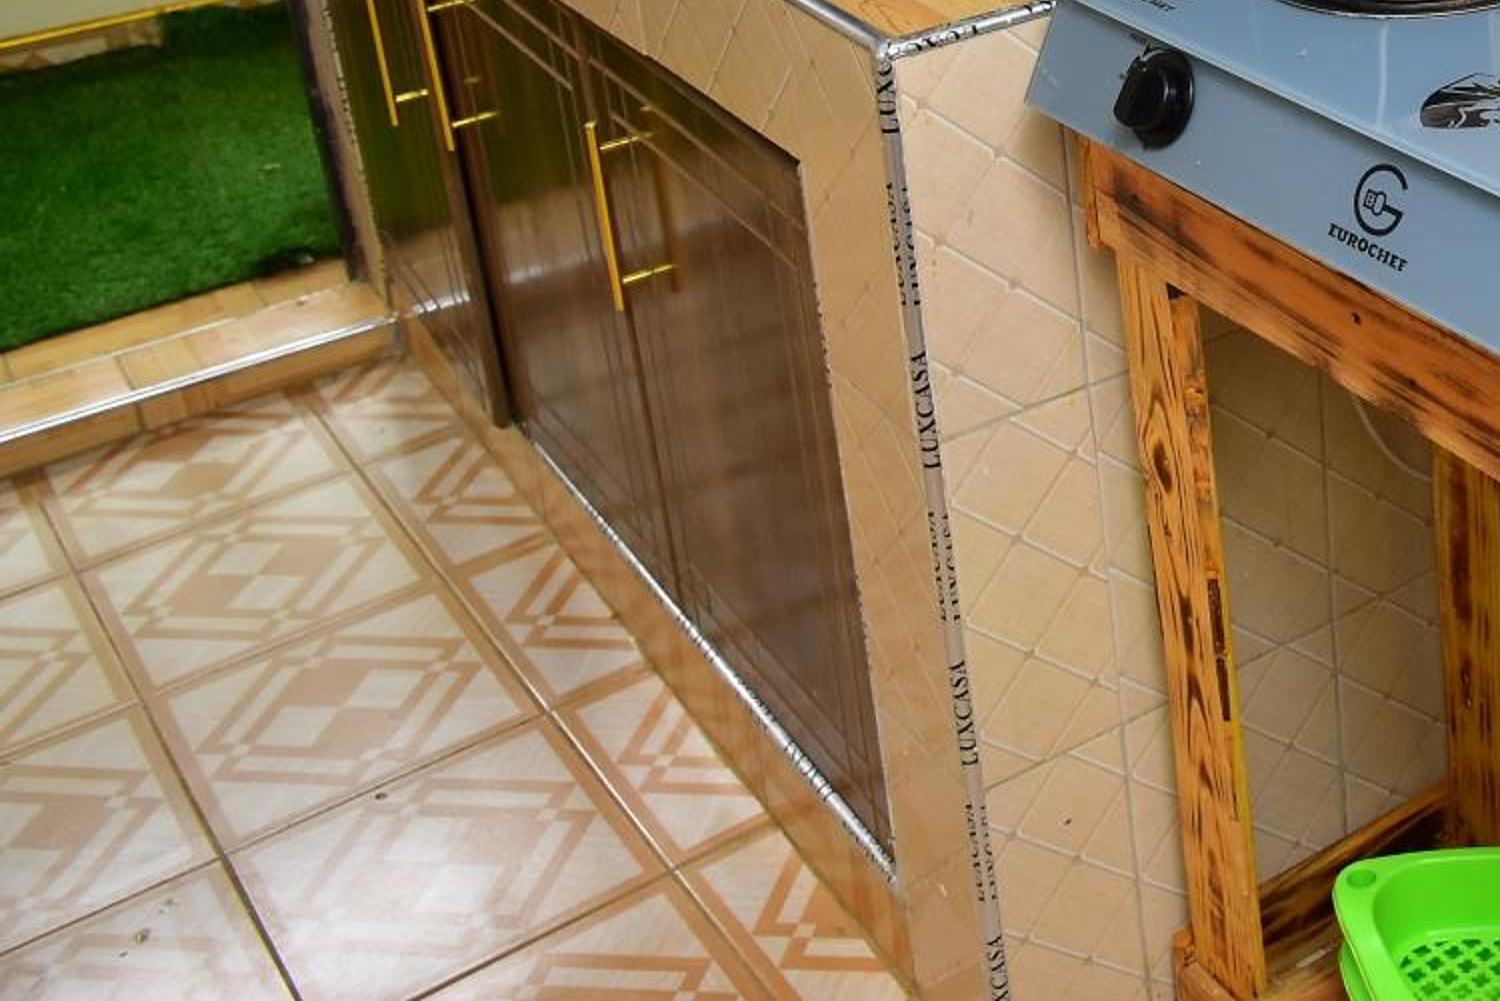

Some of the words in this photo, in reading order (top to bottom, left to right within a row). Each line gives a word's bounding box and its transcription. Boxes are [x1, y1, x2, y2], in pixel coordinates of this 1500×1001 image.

[1327, 222, 1409, 272] EUROCHEF
[910, 351, 942, 469] LUXCASA
[949, 659, 979, 766] LUXCASA
